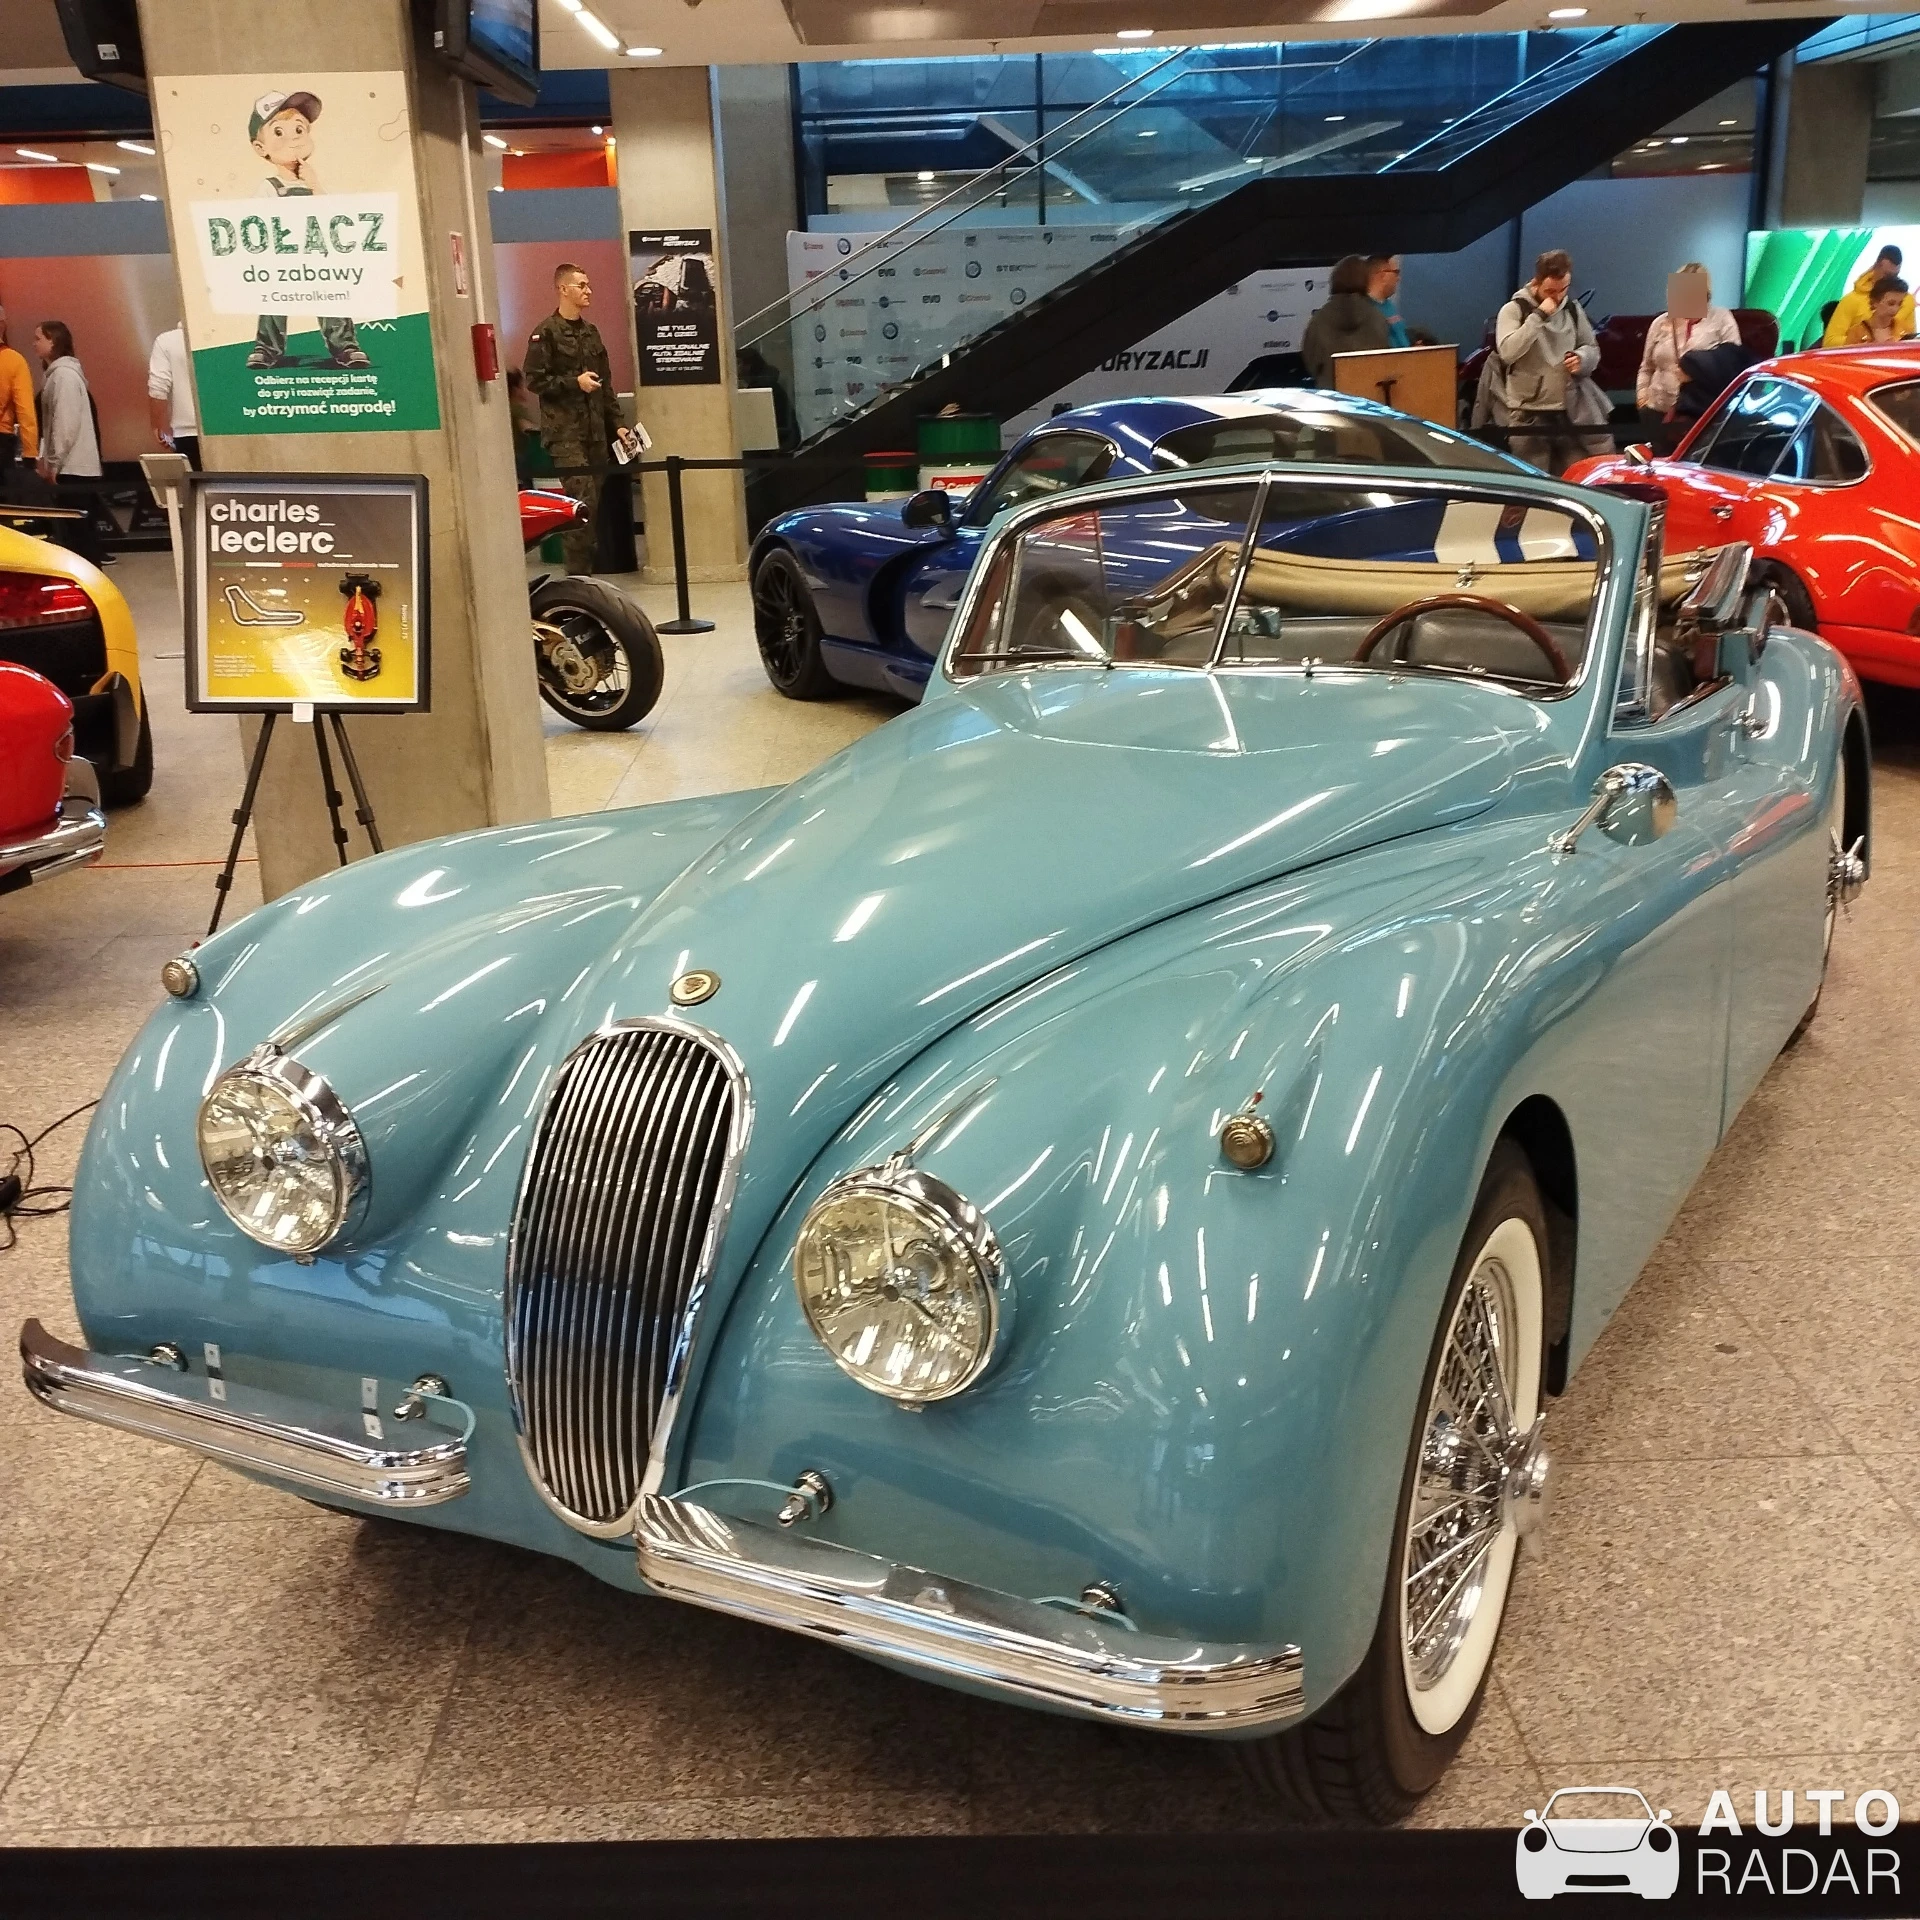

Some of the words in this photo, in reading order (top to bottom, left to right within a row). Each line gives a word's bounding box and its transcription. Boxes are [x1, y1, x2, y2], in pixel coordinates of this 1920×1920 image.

[208, 213, 388, 257] DOŁĄCZ
[243, 264, 270, 283] do
[277, 264, 364, 285] zabawy
[261, 293, 268, 303] z
[271, 291, 350, 302] Castrolkiem!
[1101, 349, 1210, 372] ORYZACJI
[254, 375, 295, 385] Odbierz
[295, 376, 310, 385] na
[310, 374, 350, 386] recepcji
[350, 374, 378, 385] kartę
[257, 388, 272, 398] do
[272, 389, 290, 399] gry
[296, 387, 335, 399] rozwiąż
[336, 386, 378, 397] zadanie,
[242, 406, 257, 417] by
[257, 401, 328, 418] otrzymać
[329, 400, 397, 417] nagrodę!
